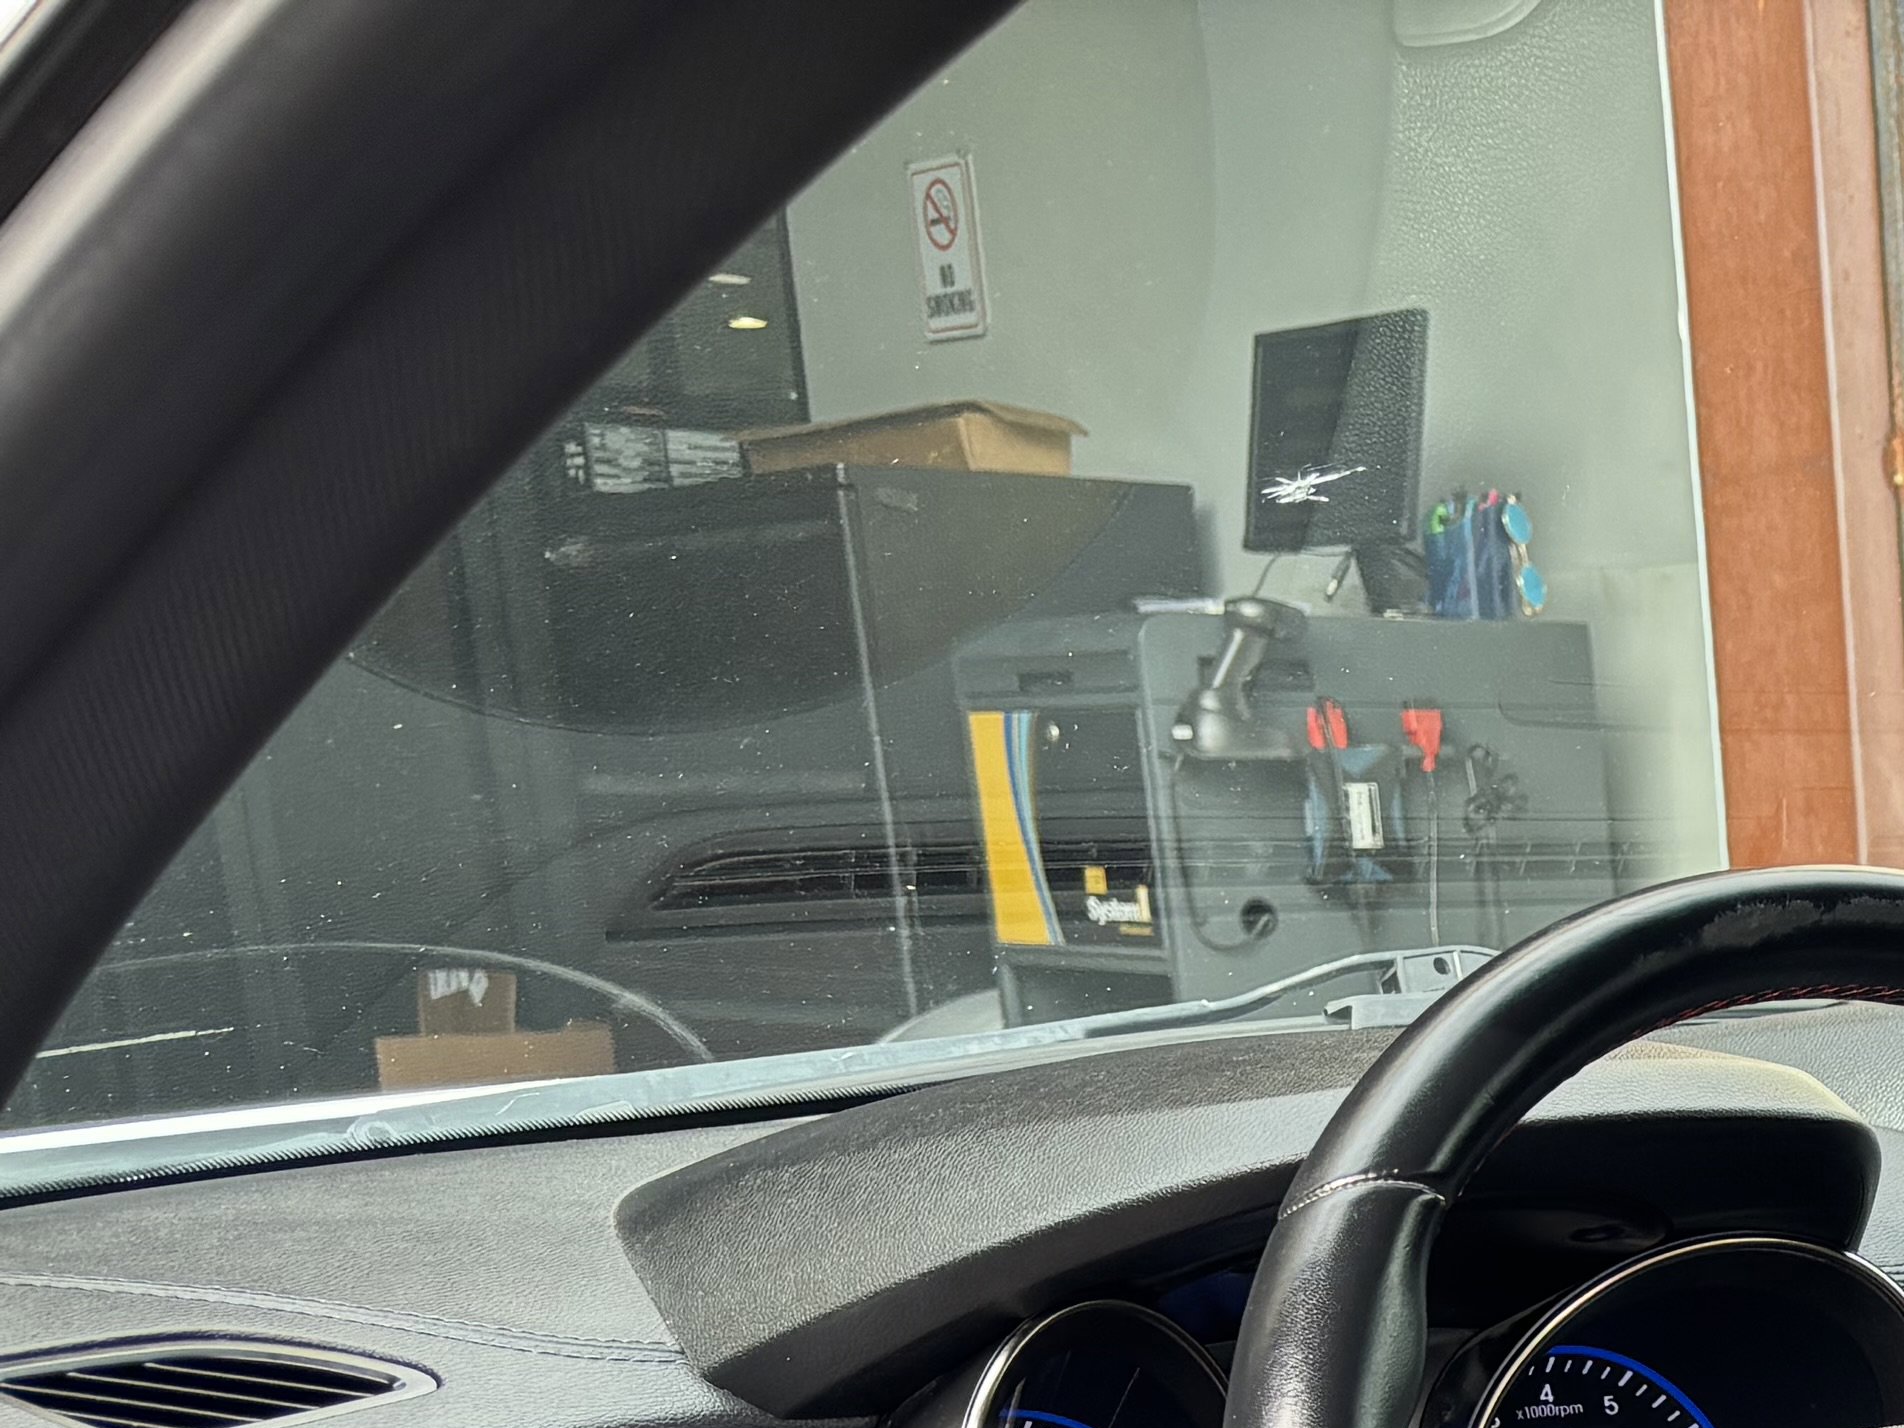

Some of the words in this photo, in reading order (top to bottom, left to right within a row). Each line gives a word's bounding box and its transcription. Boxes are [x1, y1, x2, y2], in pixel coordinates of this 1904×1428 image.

[1540, 1383, 1554, 1403] 4
[1516, 1403, 1584, 1420] x1000rpm
[1603, 1395, 1619, 1415] 5
